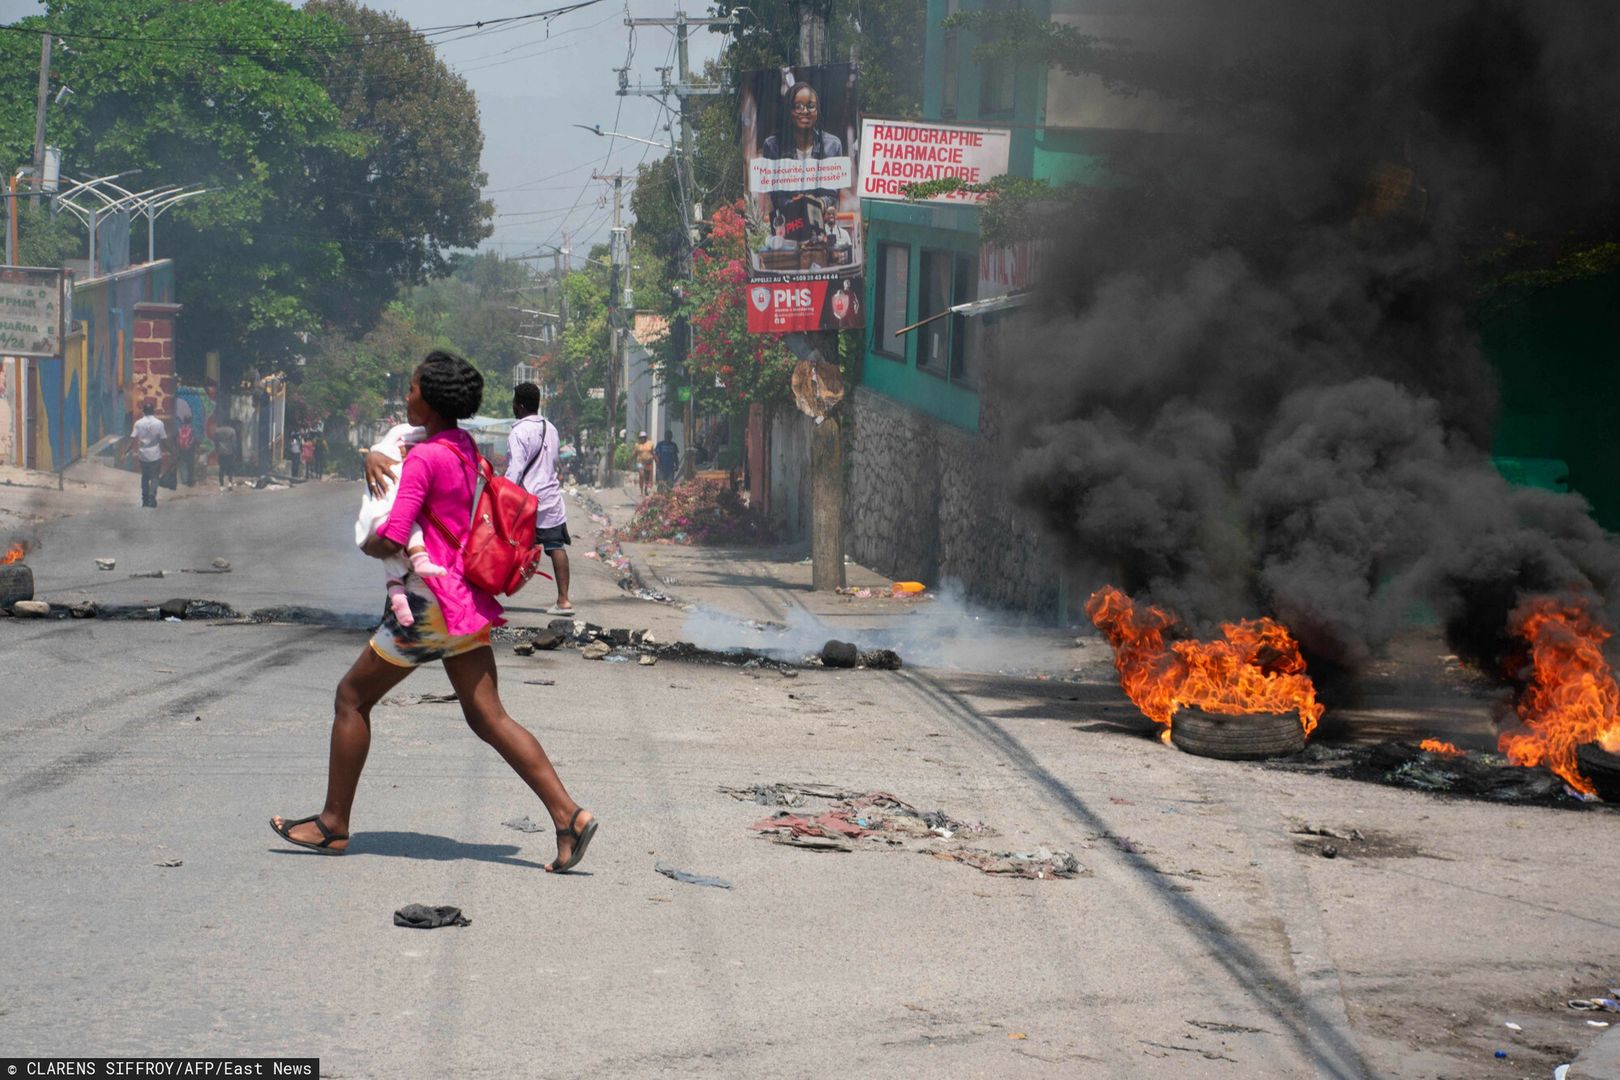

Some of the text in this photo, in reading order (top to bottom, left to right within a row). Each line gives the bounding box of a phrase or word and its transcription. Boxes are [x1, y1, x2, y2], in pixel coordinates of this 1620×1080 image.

[873, 125, 983, 147] RADIOGRAPHIE
[872, 142, 963, 164] PHARMACIE
[817, 162, 842, 172] besoin
[870, 160, 980, 183] LABORATOIRE
[761, 176, 769, 185] de
[771, 175, 805, 186] première
[774, 288, 812, 308] PHS
